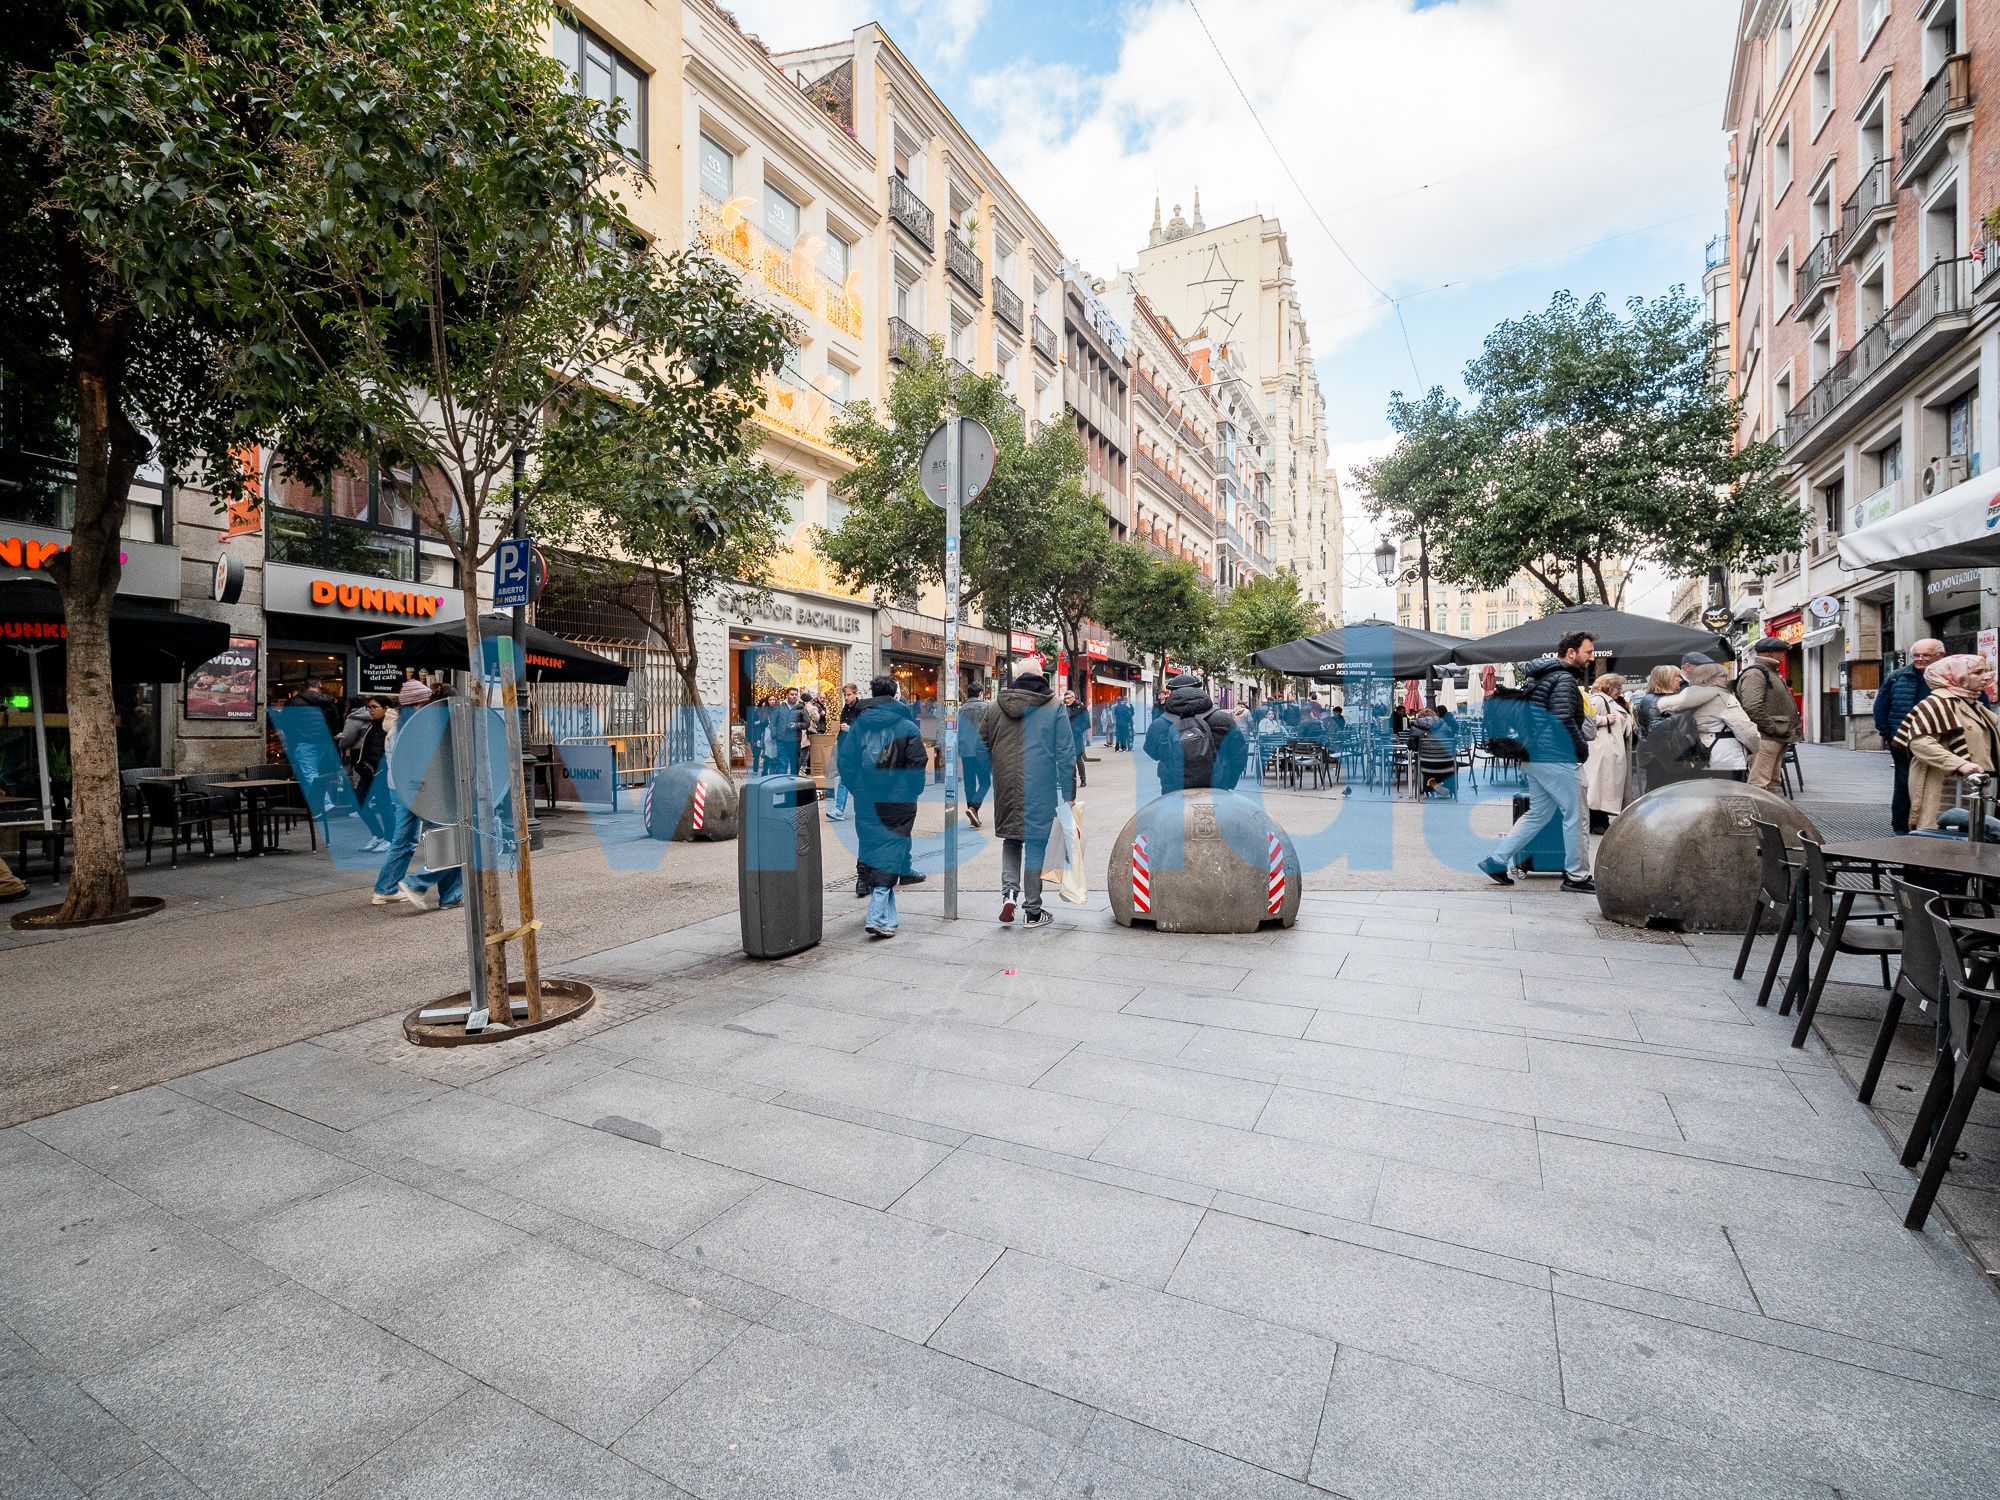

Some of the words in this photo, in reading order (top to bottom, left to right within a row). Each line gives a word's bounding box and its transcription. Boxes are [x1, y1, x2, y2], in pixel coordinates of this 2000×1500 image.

[500, 545, 519, 585] P
[313, 580, 444, 617] DUNKIN'
[498, 586, 524, 595] ABIERTO
[504, 595, 526, 603] HORAS
[796, 608, 860, 633] BACHILLER
[0, 622, 67, 638] UNKI
[525, 653, 565, 669] UNKIN'
[562, 768, 602, 780] DUNKIN'
